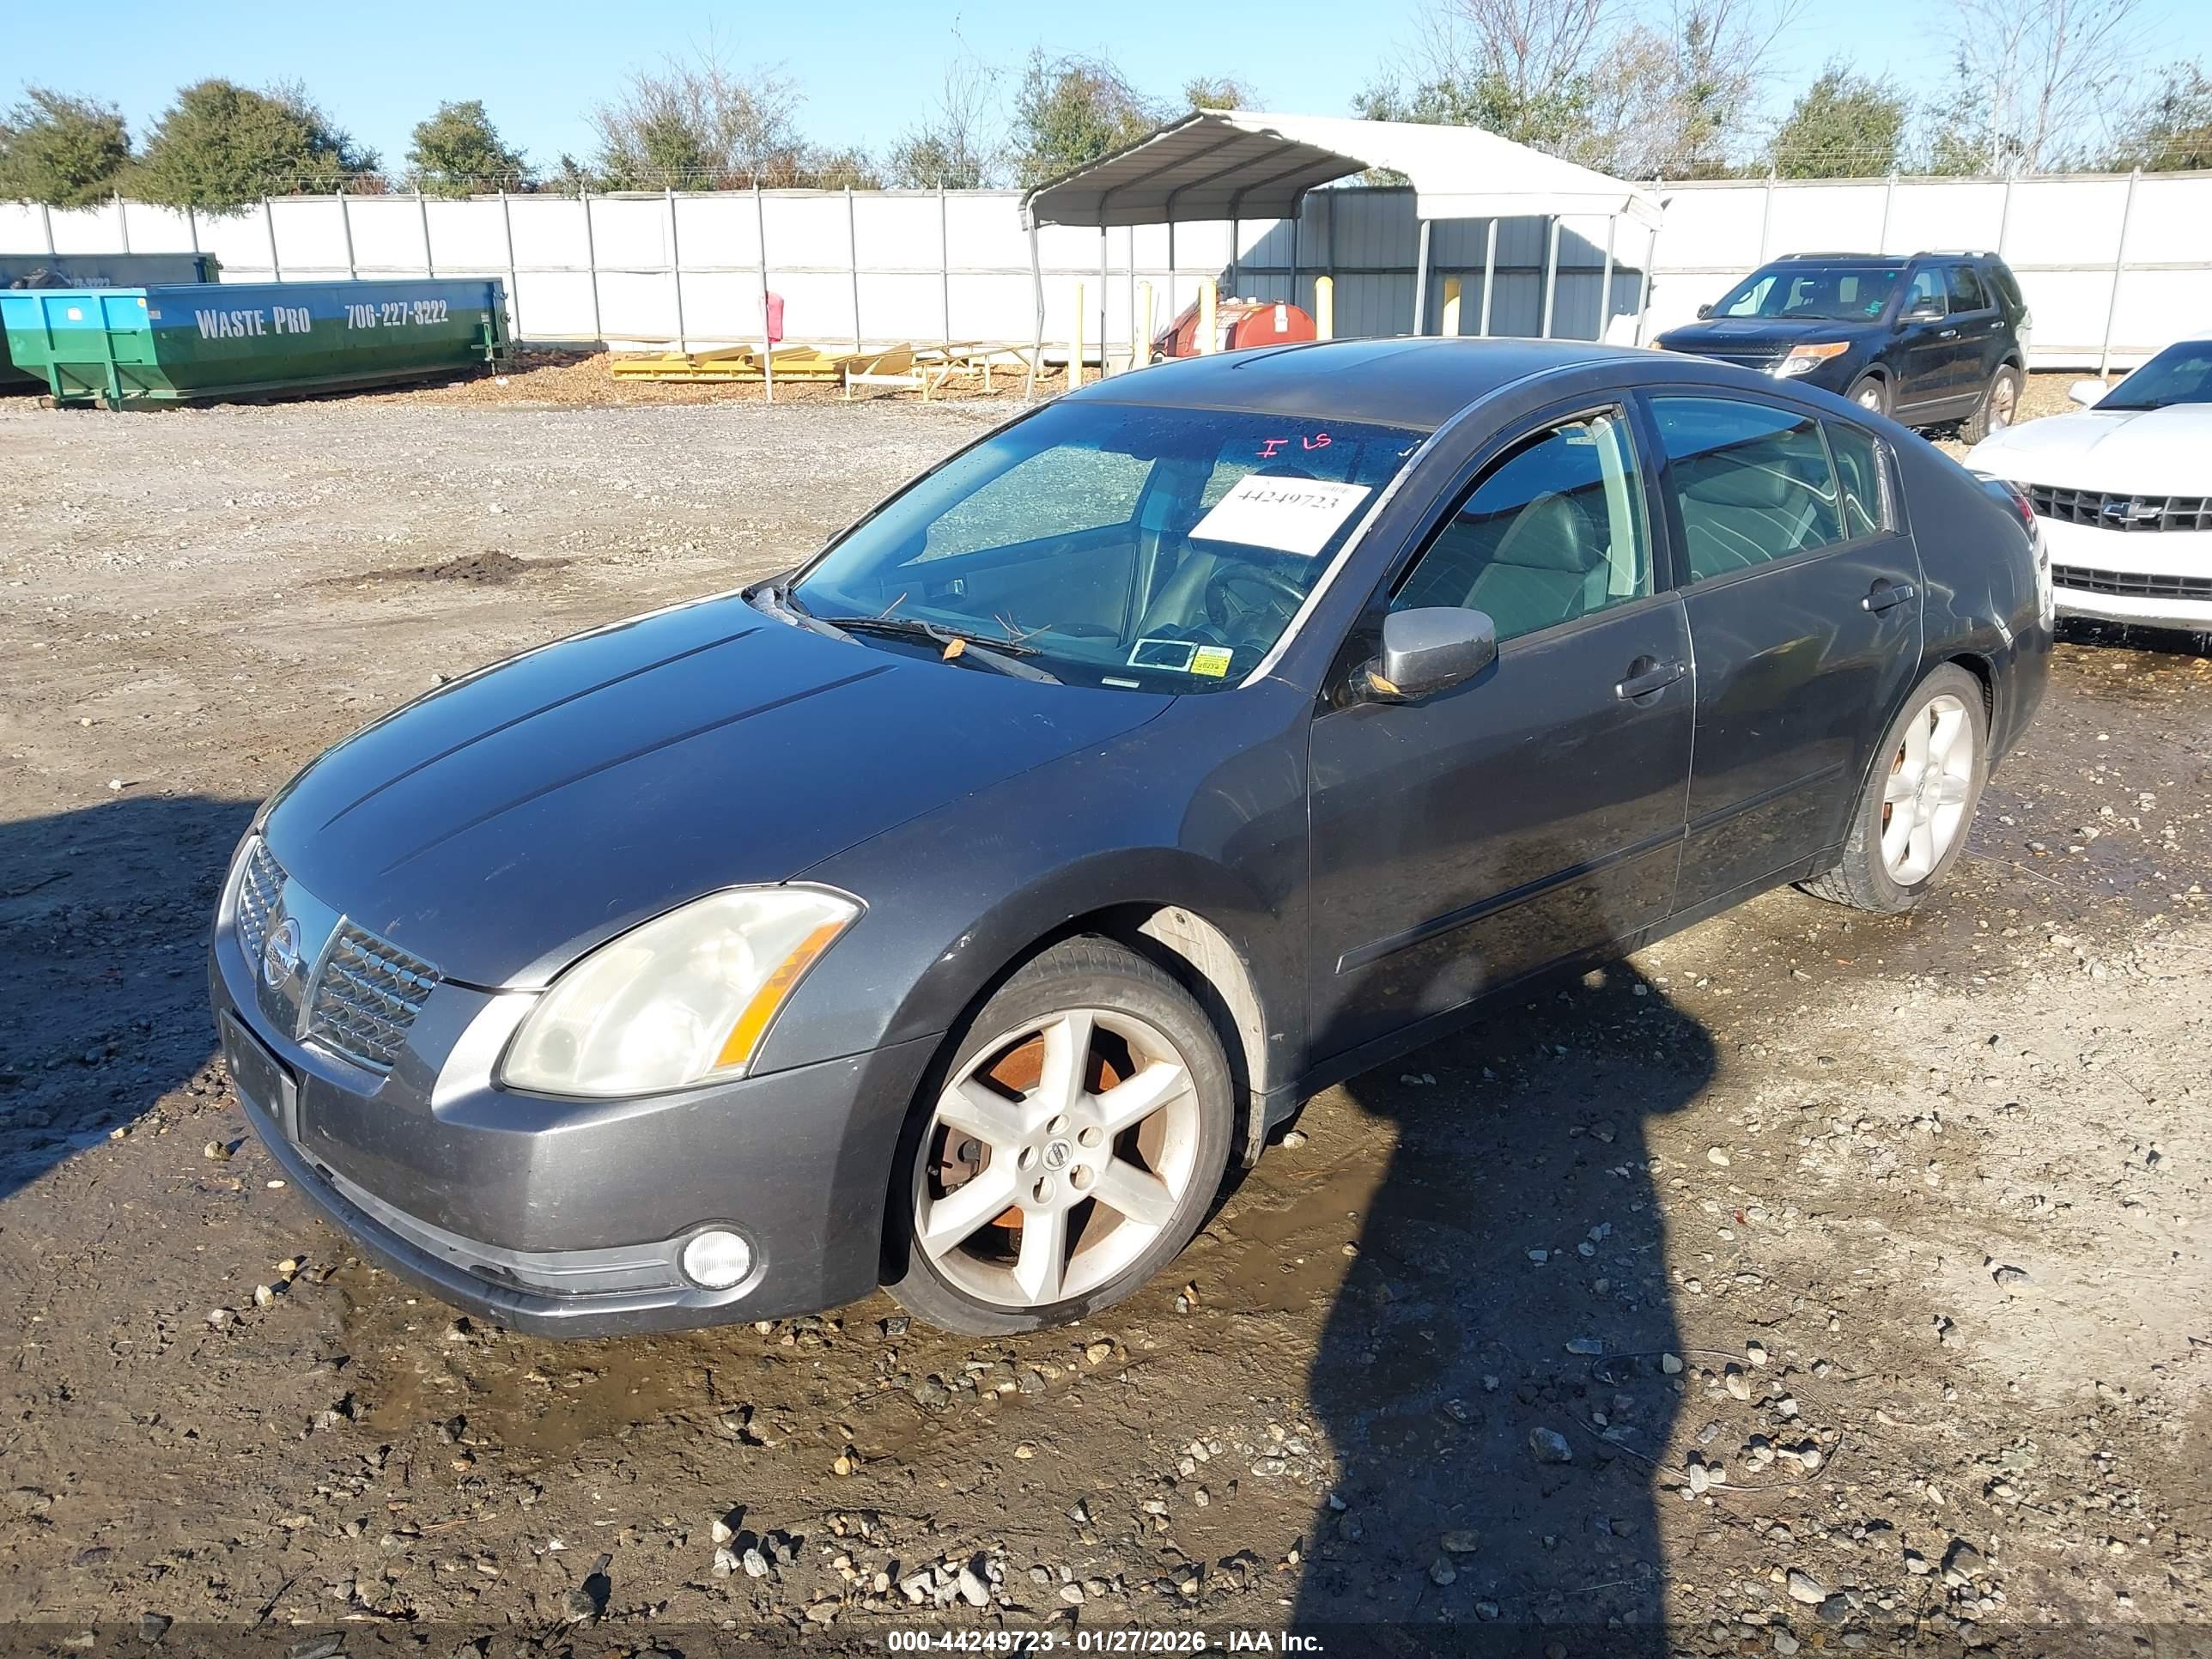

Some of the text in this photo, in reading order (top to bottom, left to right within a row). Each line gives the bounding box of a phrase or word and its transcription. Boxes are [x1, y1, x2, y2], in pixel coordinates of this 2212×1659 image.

[194, 306, 312, 339] WASTE PRO
[344, 299, 449, 330] 706-227-3222
[1237, 490, 1340, 509] 44249723
